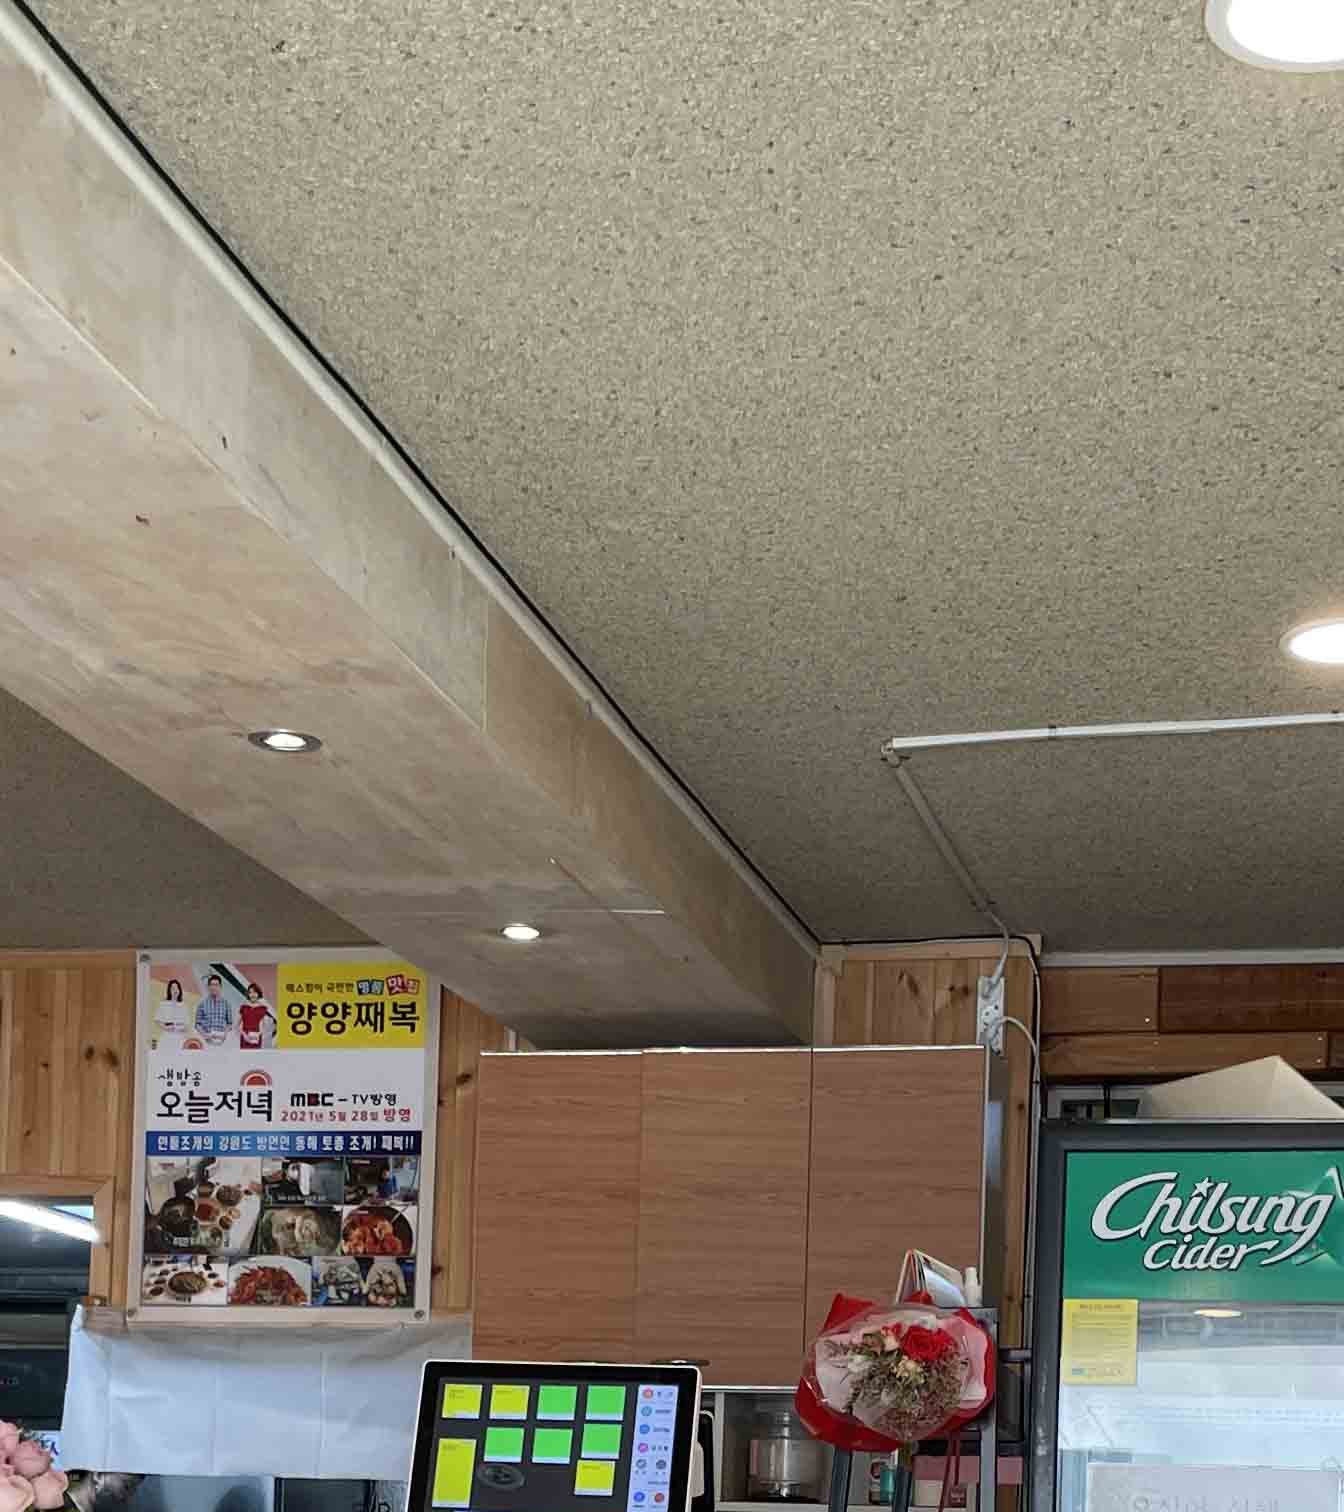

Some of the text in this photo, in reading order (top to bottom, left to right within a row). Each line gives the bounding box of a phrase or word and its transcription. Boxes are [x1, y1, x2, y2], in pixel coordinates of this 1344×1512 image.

[287, 1001, 420, 1035] 양양째복
[156, 1090, 272, 1123] 오늘저녁
[290, 1093, 334, 1107] MBC
[384, 1108, 411, 1122] 방영
[1092, 1168, 1333, 1266] Chilsung
[1143, 1237, 1260, 1271] Cider
